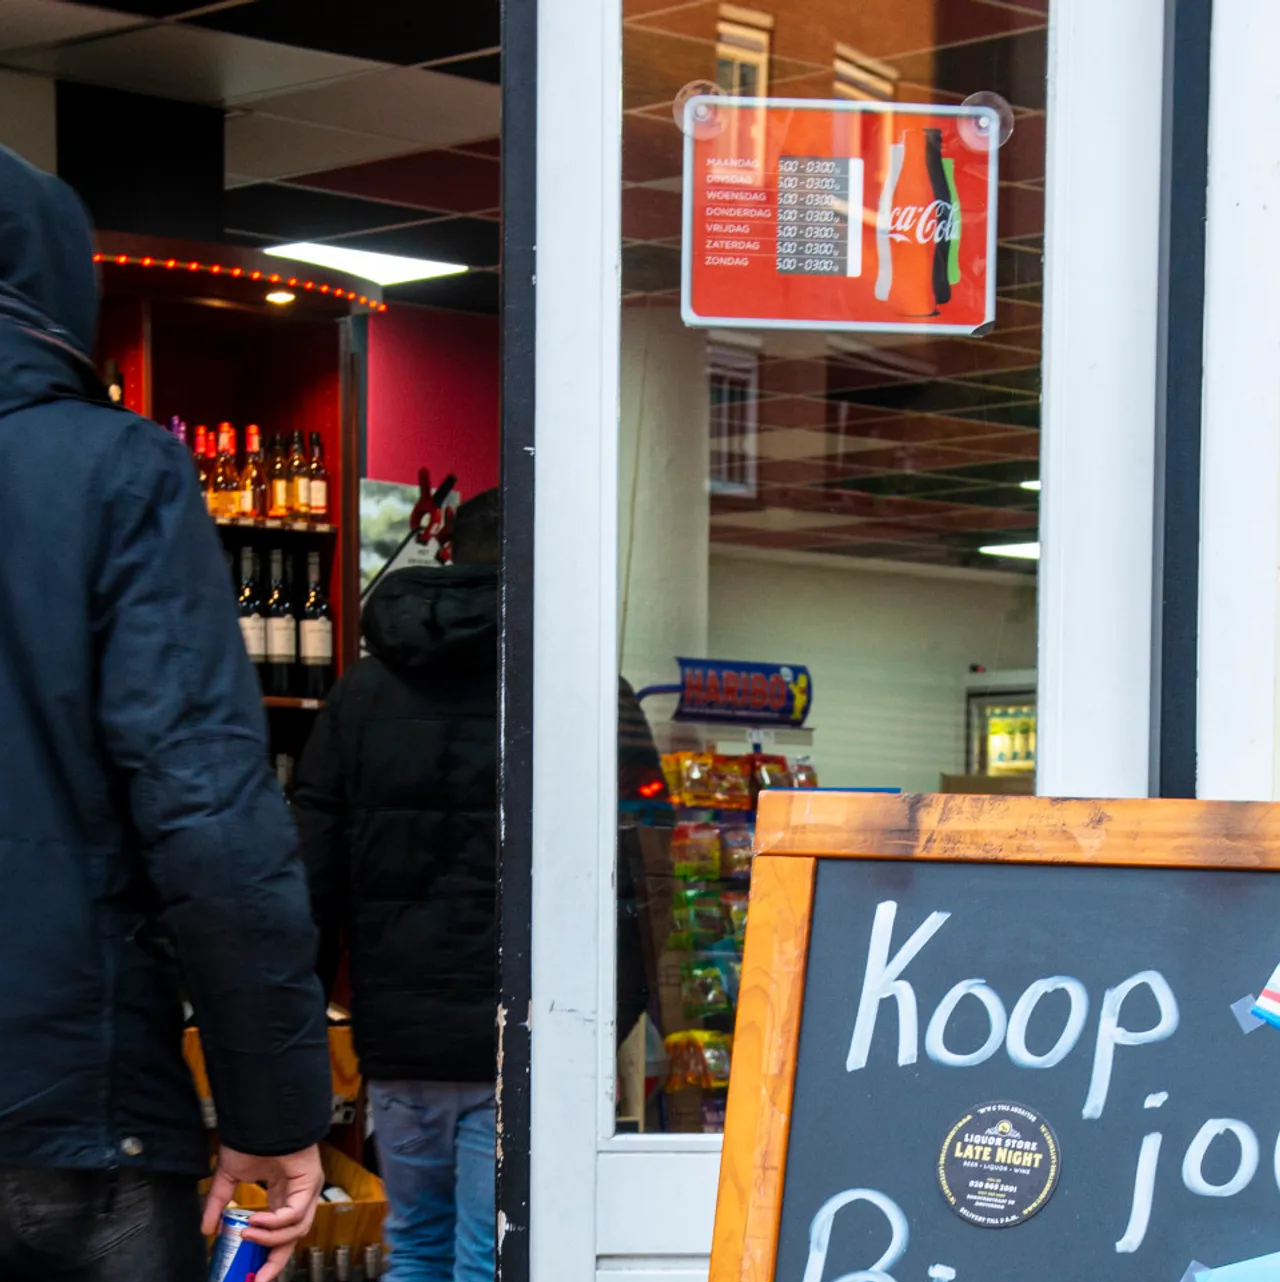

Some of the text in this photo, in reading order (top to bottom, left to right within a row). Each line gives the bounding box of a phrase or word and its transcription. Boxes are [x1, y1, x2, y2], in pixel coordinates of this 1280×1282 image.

[706, 158, 759, 168] MAANDAG
[706, 175, 753, 184] DINSDAG
[706, 191, 767, 201] WOENSDAG
[705, 207, 772, 217] DONDERDAG
[705, 224, 750, 233] VRIJDAG
[705, 240, 760, 250] ZATERDAG
[704, 256, 749, 266] ZONDAG
[684, 667, 786, 709] HARIBO
[845, 900, 1180, 1120] Koop
[964, 1133, 1038, 1151] LIQUOR STORE
[954, 1142, 1043, 1168] LATE NIGHT
[963, 1160, 1031, 1175] BEER LIQUOR WINE
[969, 1180, 983, 1188] 020
